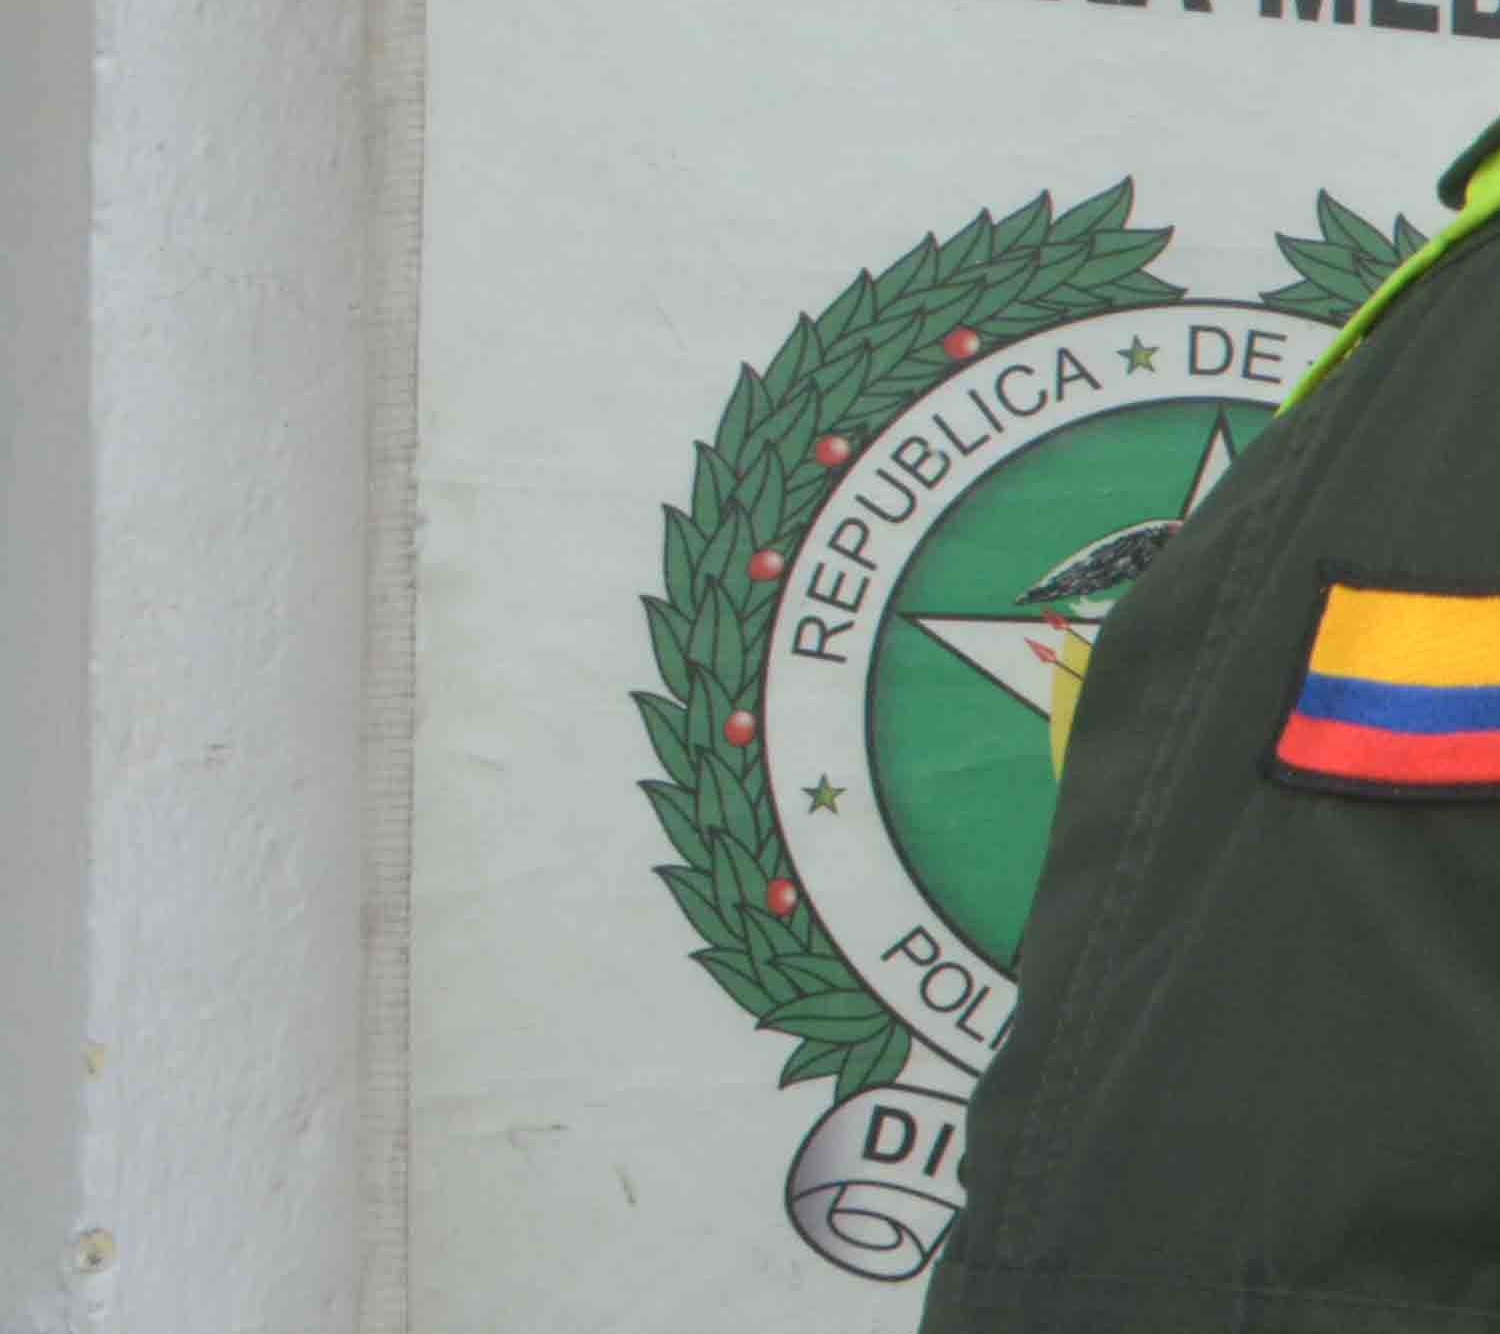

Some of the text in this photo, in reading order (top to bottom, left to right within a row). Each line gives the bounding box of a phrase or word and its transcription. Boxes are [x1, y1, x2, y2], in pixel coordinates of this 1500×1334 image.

[790, 323, 1289, 666] REPUBLICA DE
[861, 1105, 956, 1178] DI
